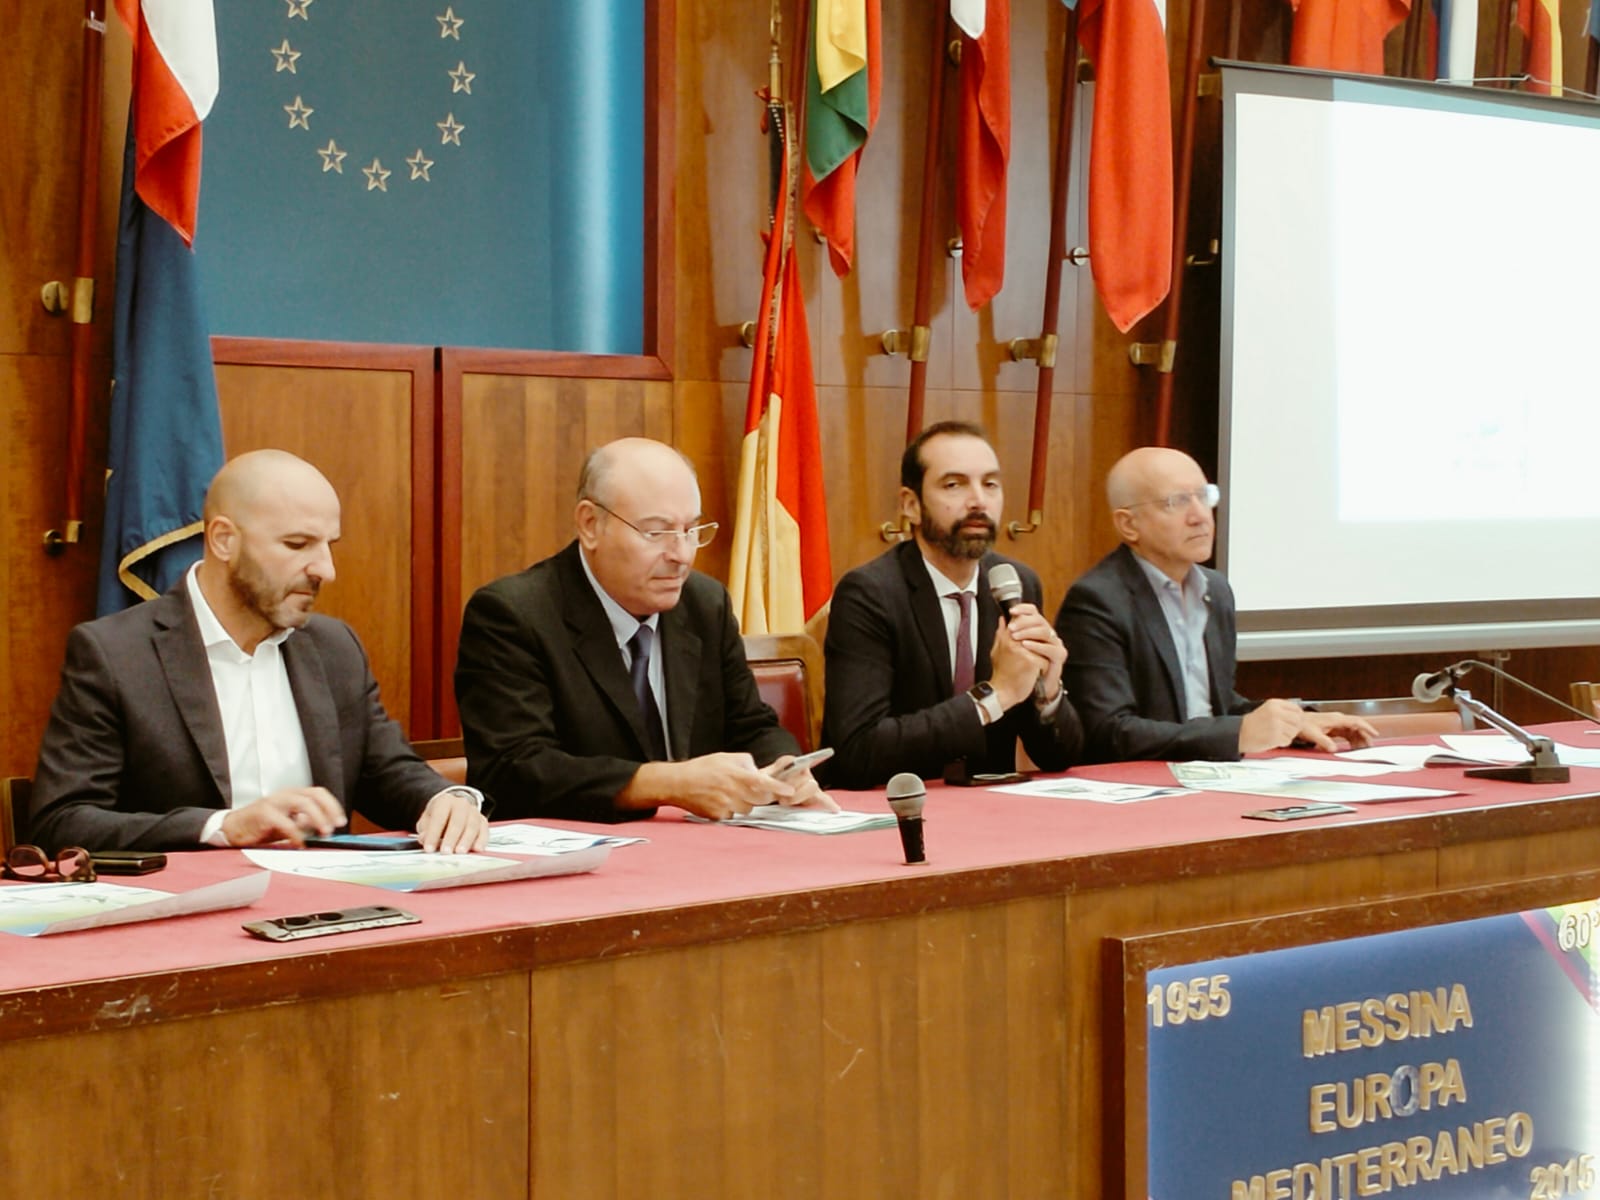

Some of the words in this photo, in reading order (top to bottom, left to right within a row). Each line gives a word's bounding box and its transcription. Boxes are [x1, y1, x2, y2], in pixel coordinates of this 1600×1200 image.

[1147, 974, 1231, 1027] 1955
[1303, 983, 1473, 1058] MESSINA
[1310, 1058, 1467, 1133] EUROPA
[1529, 1154, 1595, 1200] 2015
